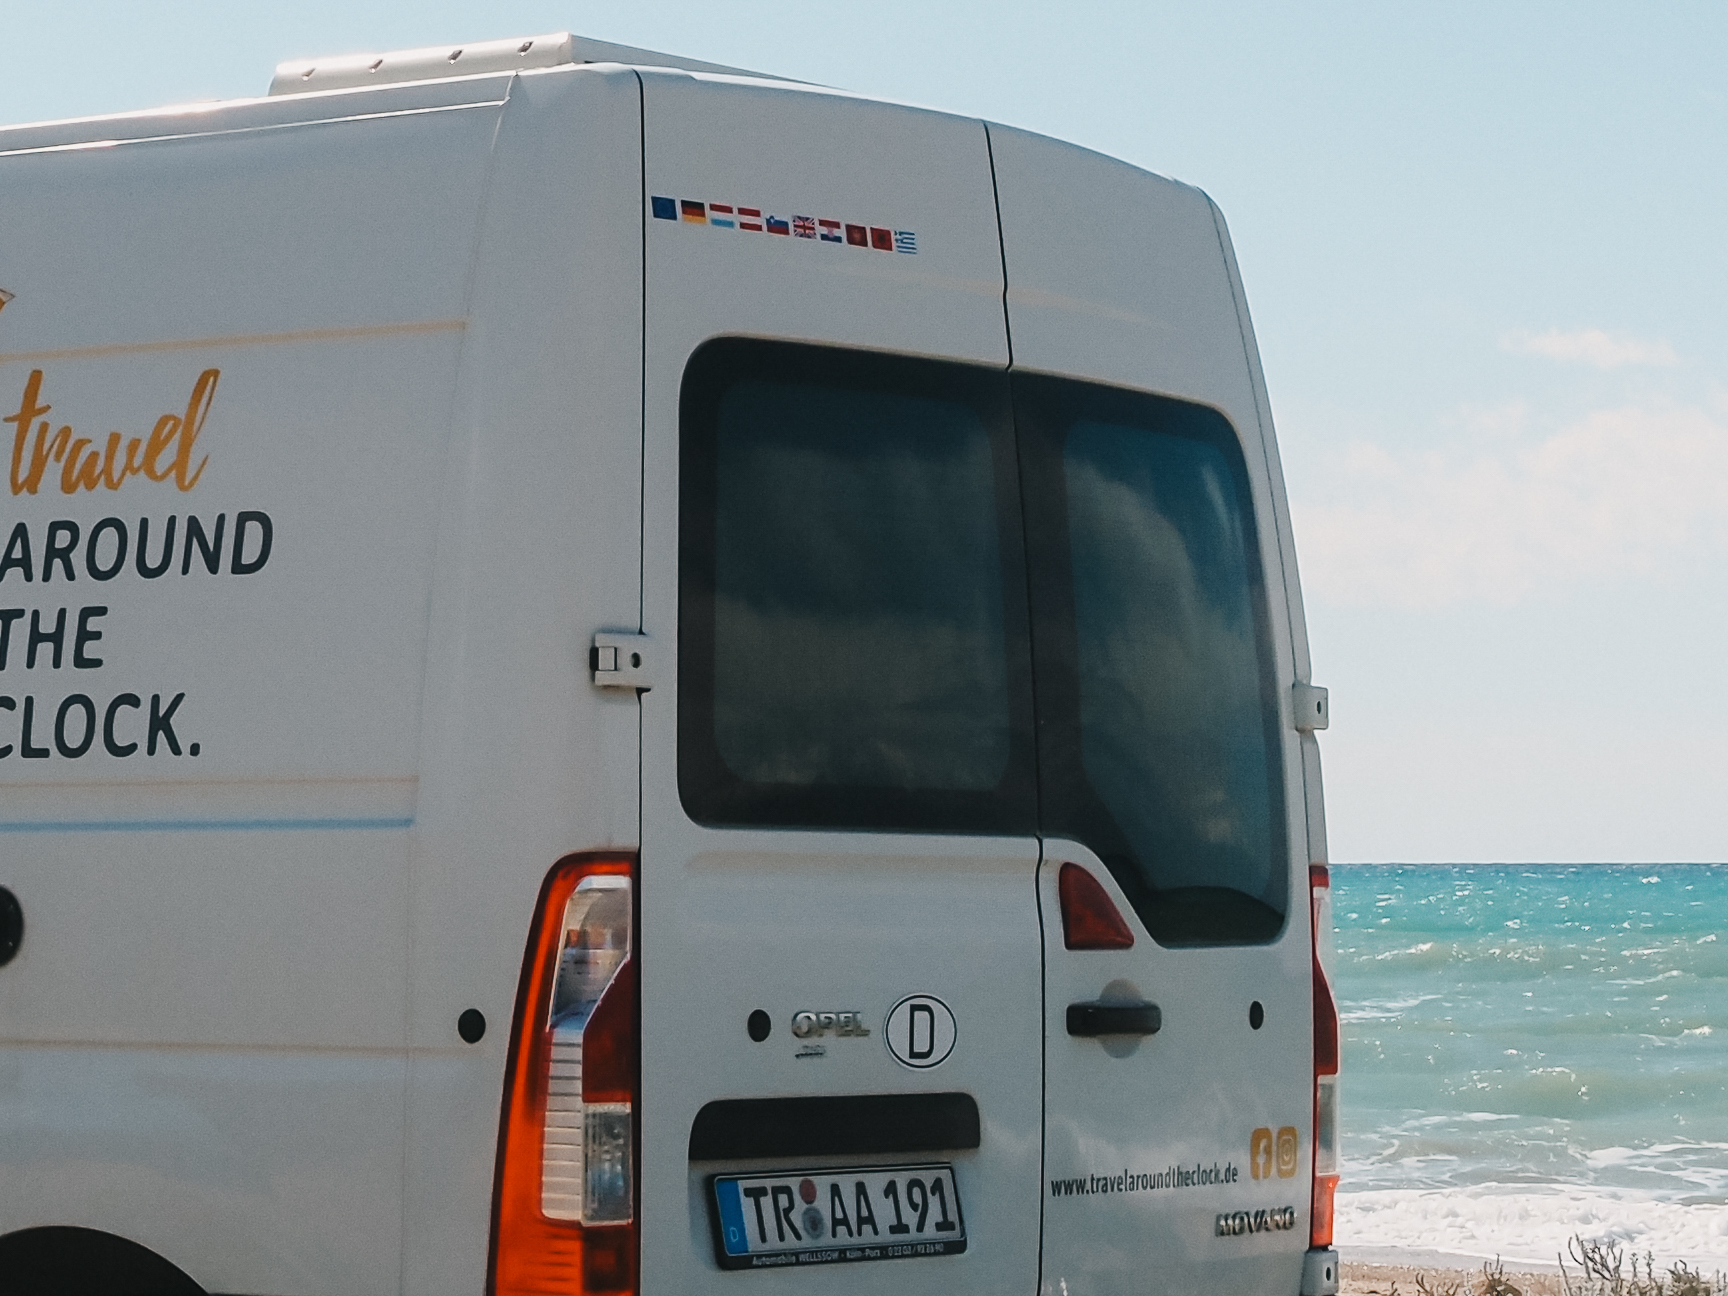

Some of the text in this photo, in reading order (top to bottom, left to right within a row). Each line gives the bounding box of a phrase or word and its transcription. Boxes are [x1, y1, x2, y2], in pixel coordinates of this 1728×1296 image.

[3, 368, 221, 496] travel
[791, 1011, 871, 1039] OPEL
[909, 1003, 935, 1060] D
[1050, 1161, 1239, 1197] www.travelaroundtheclock.de
[743, 1176, 957, 1244] TR AA 191
